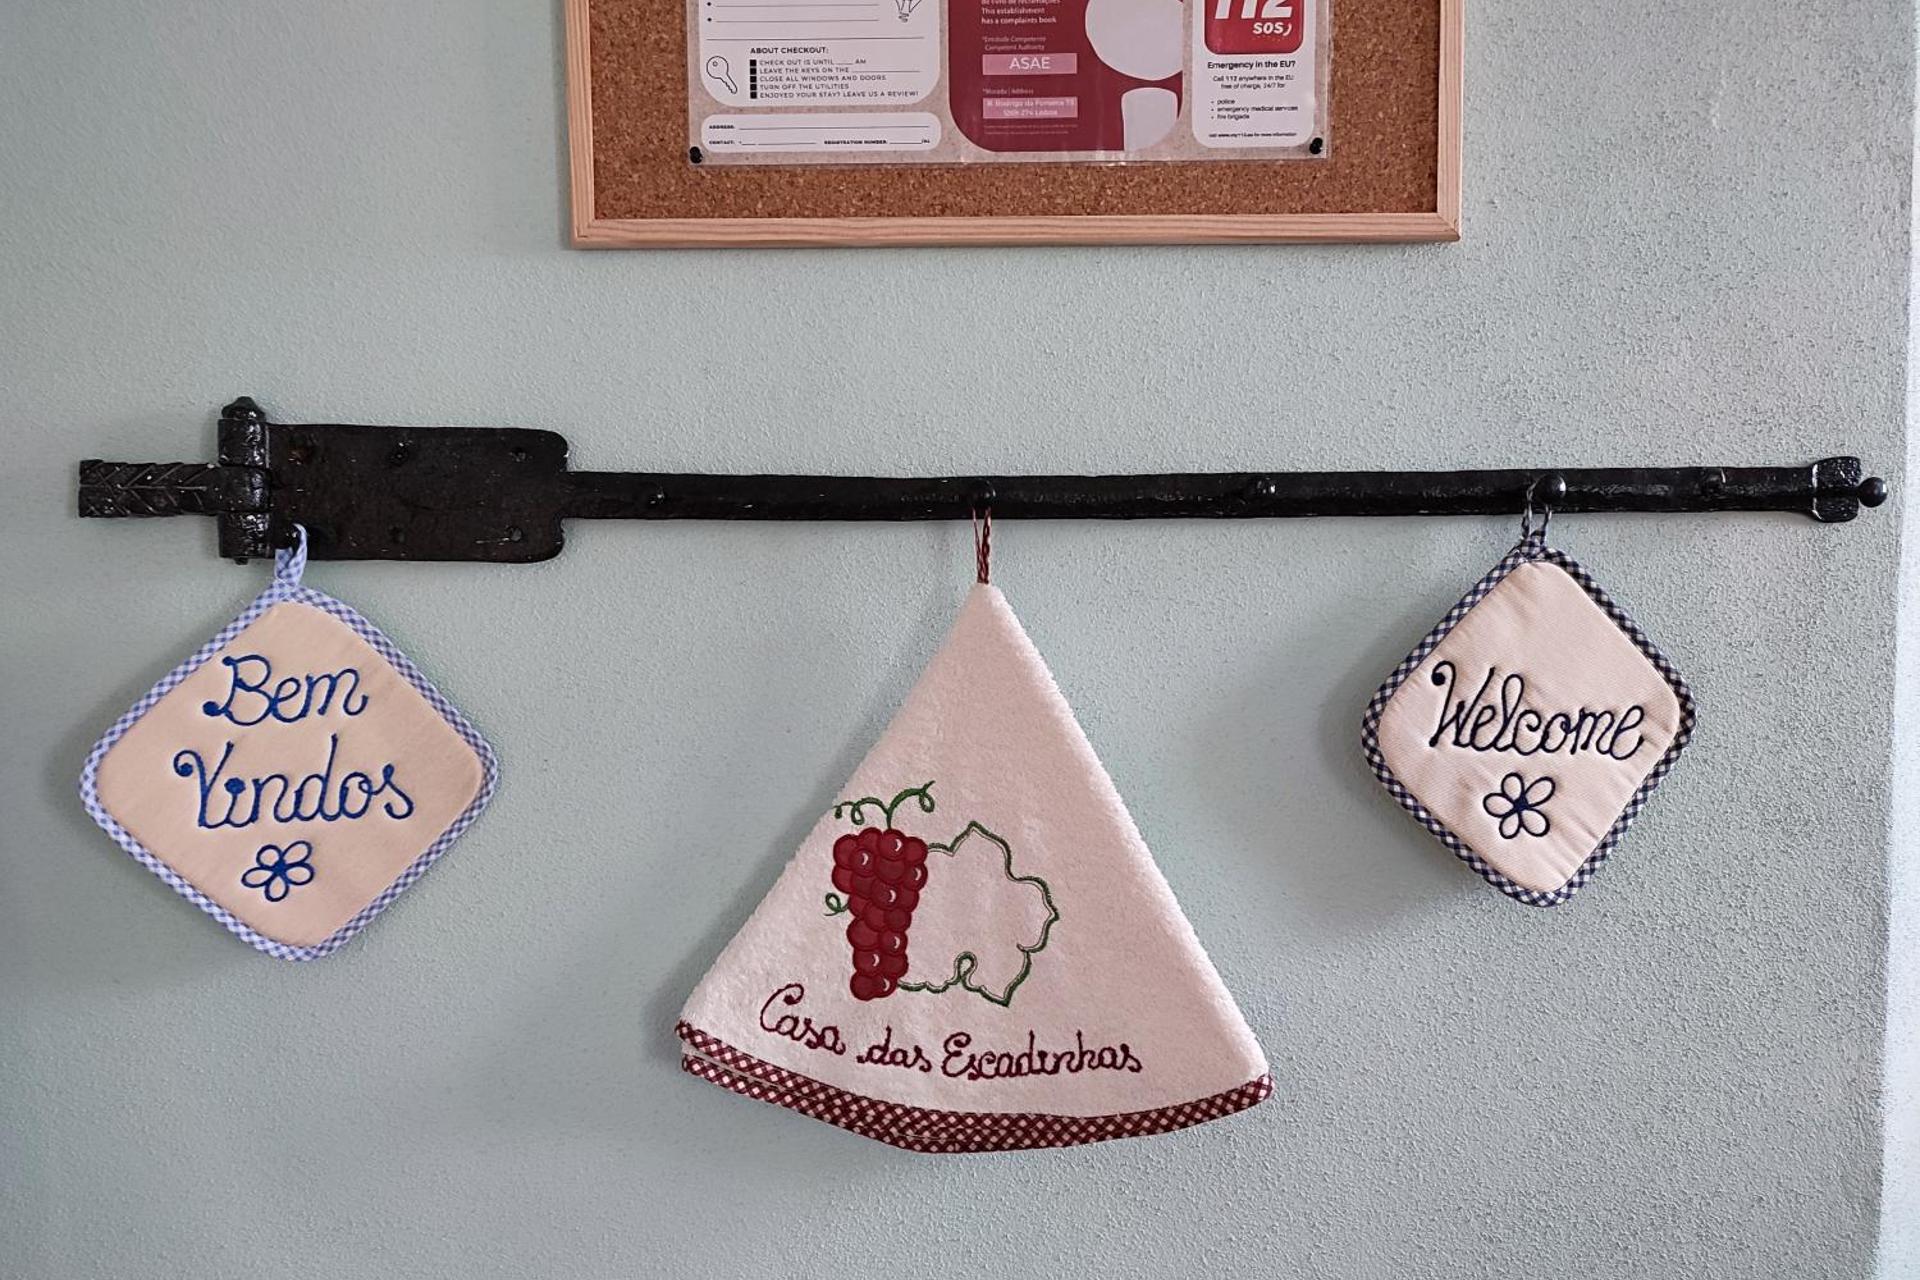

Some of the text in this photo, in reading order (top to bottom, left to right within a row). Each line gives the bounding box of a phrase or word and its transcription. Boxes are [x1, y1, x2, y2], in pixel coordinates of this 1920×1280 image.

[981, 16, 993, 24] has
[1000, 17, 1038, 26] complaints
[1252, 22, 1284, 34] SOS
[780, 46, 829, 54] CHECKOUT:
[1008, 56, 1051, 70] ASAE
[1207, 61, 1253, 70] Emergency
[1280, 60, 1296, 68] EU?
[202, 654, 369, 726] Bem
[1428, 660, 1645, 760] Welcome
[173, 733, 414, 829] Vindos
[759, 983, 1142, 1081] Casa das Escadinhas
